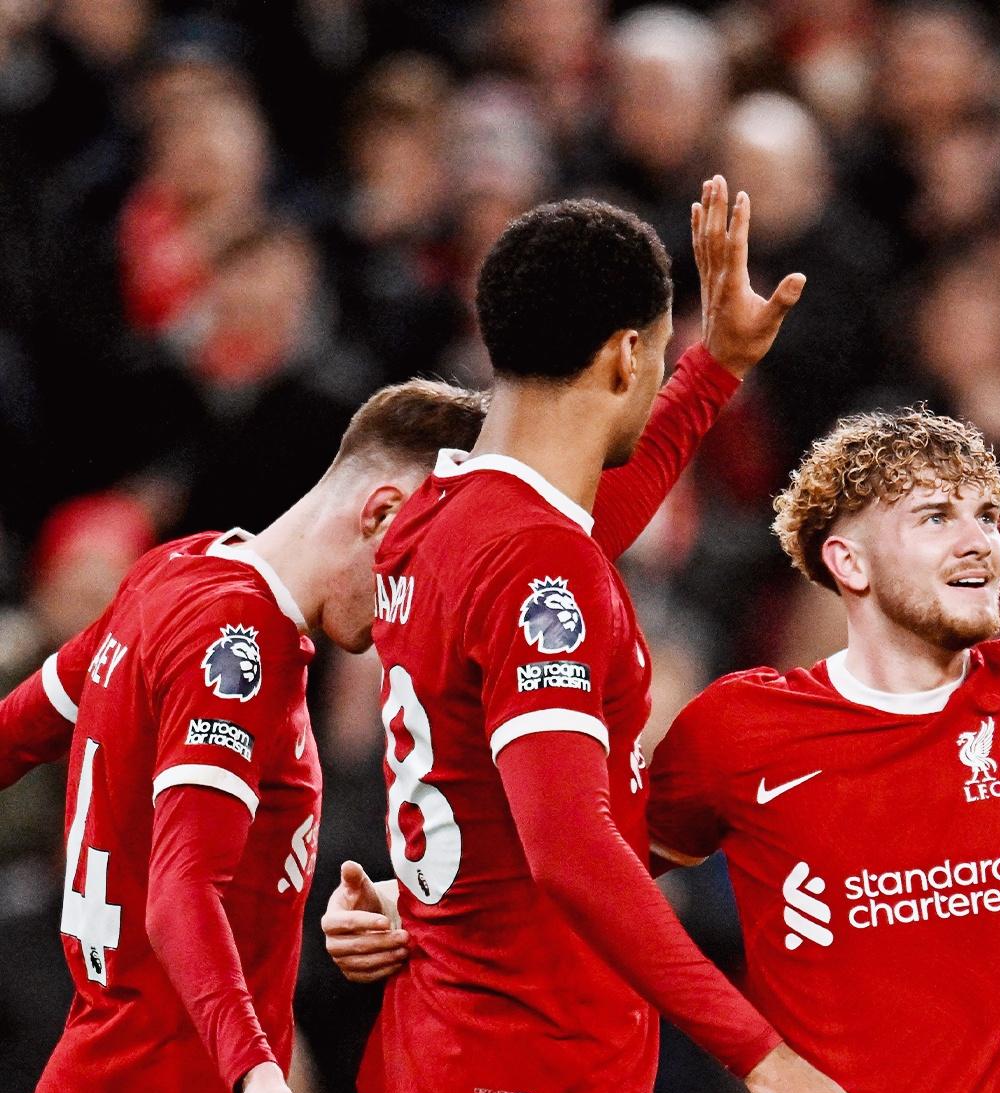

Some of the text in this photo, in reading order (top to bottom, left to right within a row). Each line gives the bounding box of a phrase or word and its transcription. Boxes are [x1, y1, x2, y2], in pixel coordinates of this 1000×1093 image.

[517, 663, 586, 679] No room
[516, 678, 541, 693] for
[184, 731, 208, 746] for
[189, 718, 250, 748] No room
[380, 664, 462, 905] 8
